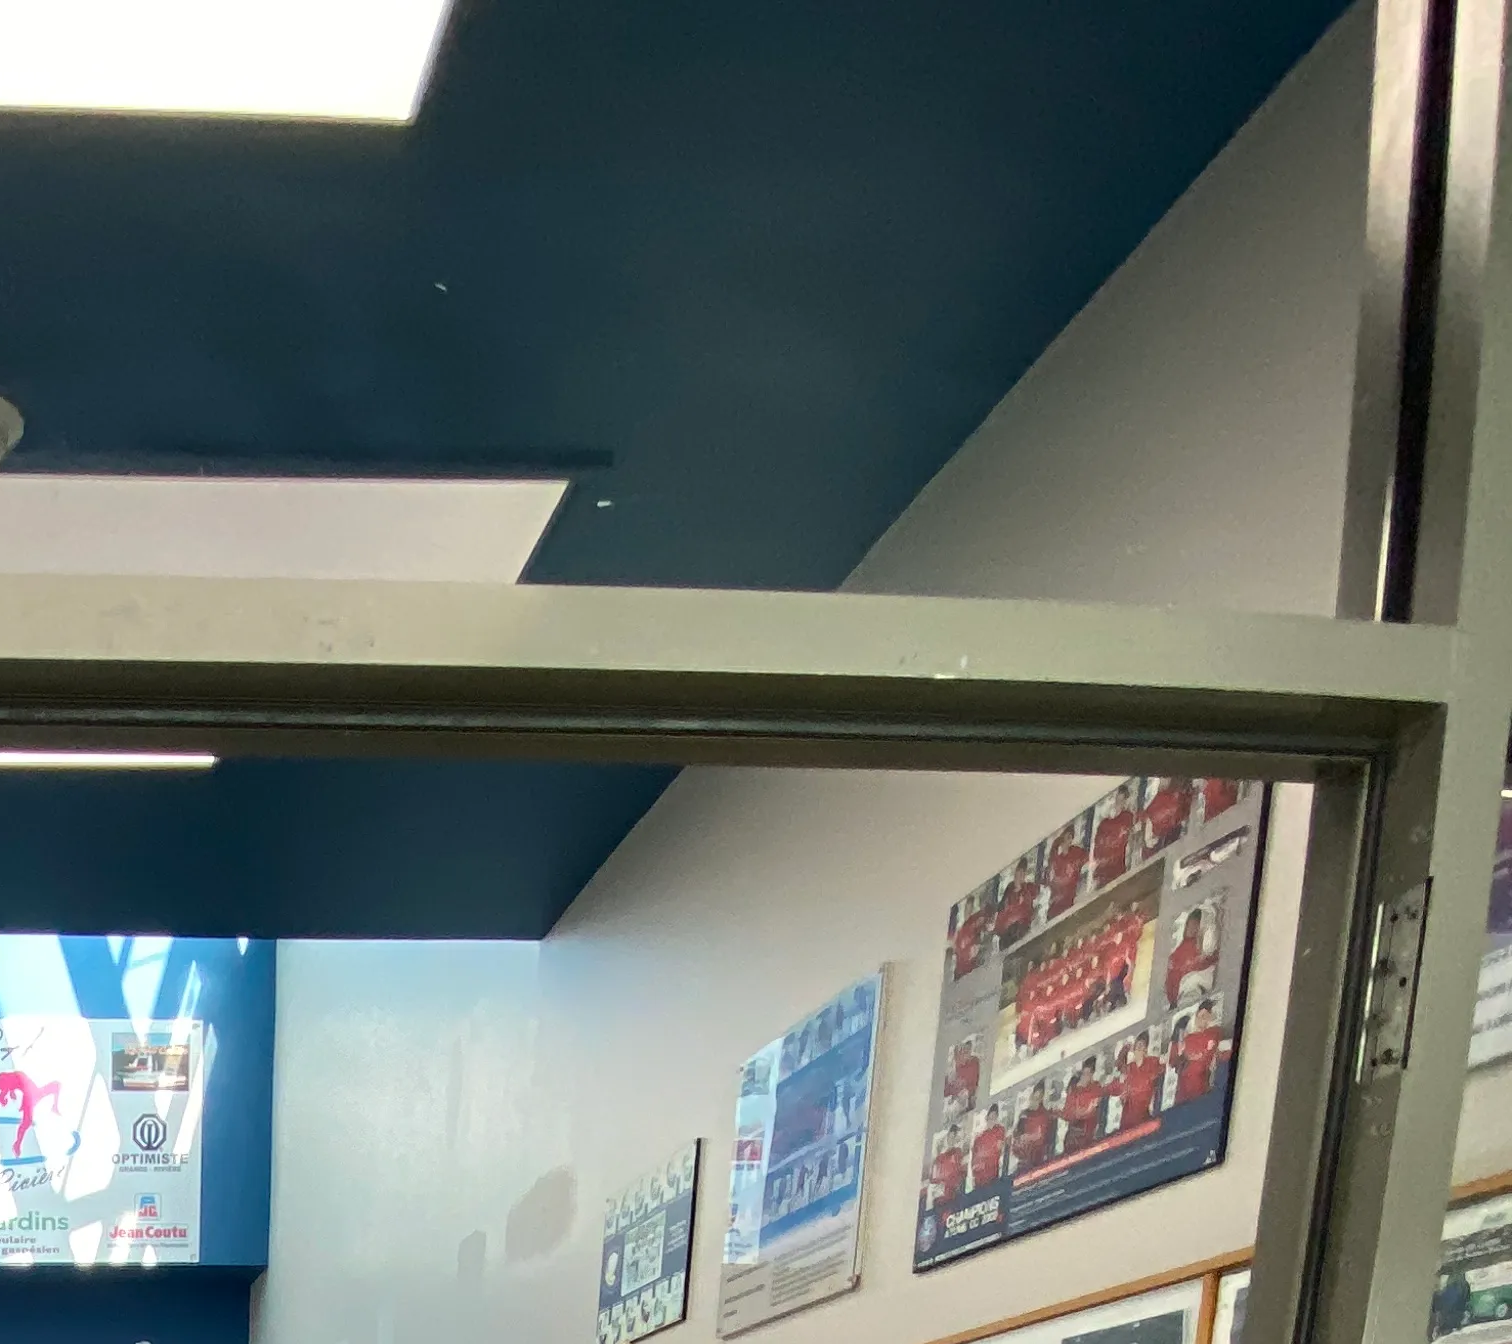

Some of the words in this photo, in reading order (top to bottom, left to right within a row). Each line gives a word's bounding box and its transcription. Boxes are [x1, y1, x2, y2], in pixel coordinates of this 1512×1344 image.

[112, 1153, 189, 1165] OPTIMISTE
[946, 1196, 1000, 1228] CHAMPIONS
[109, 1225, 144, 1238] Jean
[145, 1225, 187, 1238] Coutu
